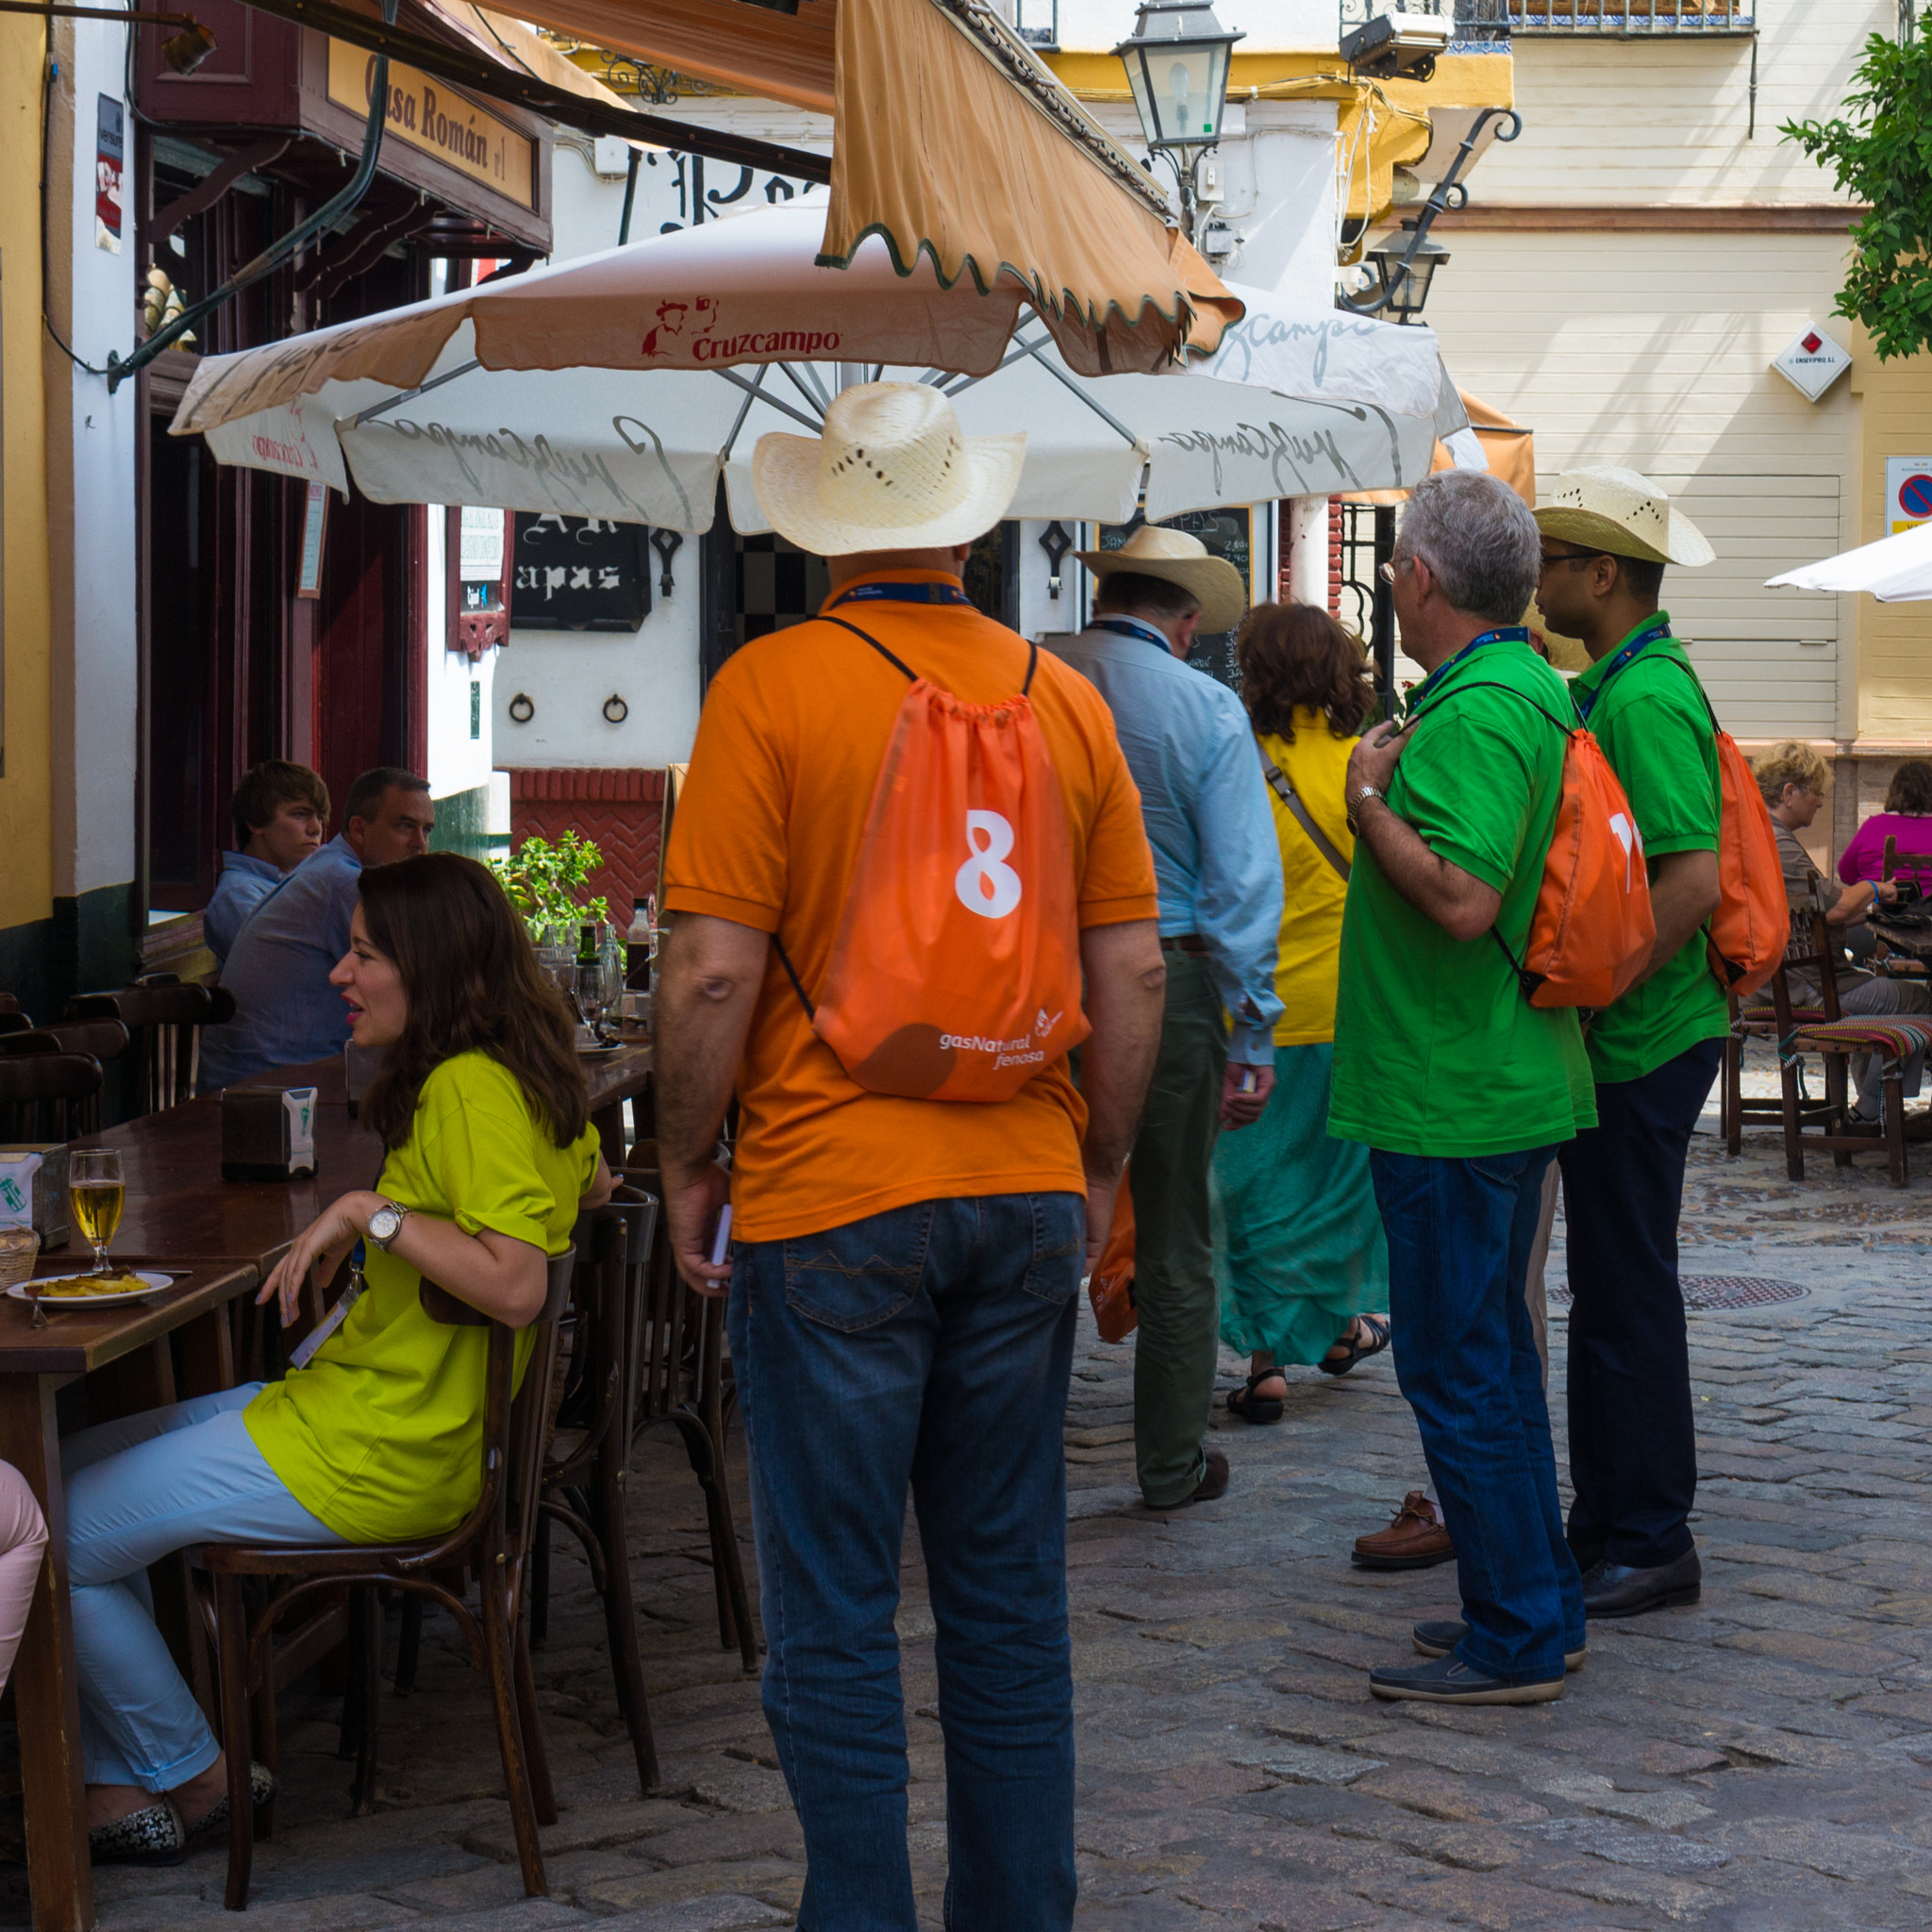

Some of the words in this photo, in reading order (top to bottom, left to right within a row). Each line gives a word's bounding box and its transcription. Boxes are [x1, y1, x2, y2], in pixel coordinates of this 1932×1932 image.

[421, 86, 488, 170] Román
[691, 330, 841, 362] Cruzcampo
[515, 566, 621, 602] apas
[955, 809, 1022, 919] 8
[940, 1034, 1031, 1053] gasNatural
[992, 1050, 1044, 1070] fenosa
